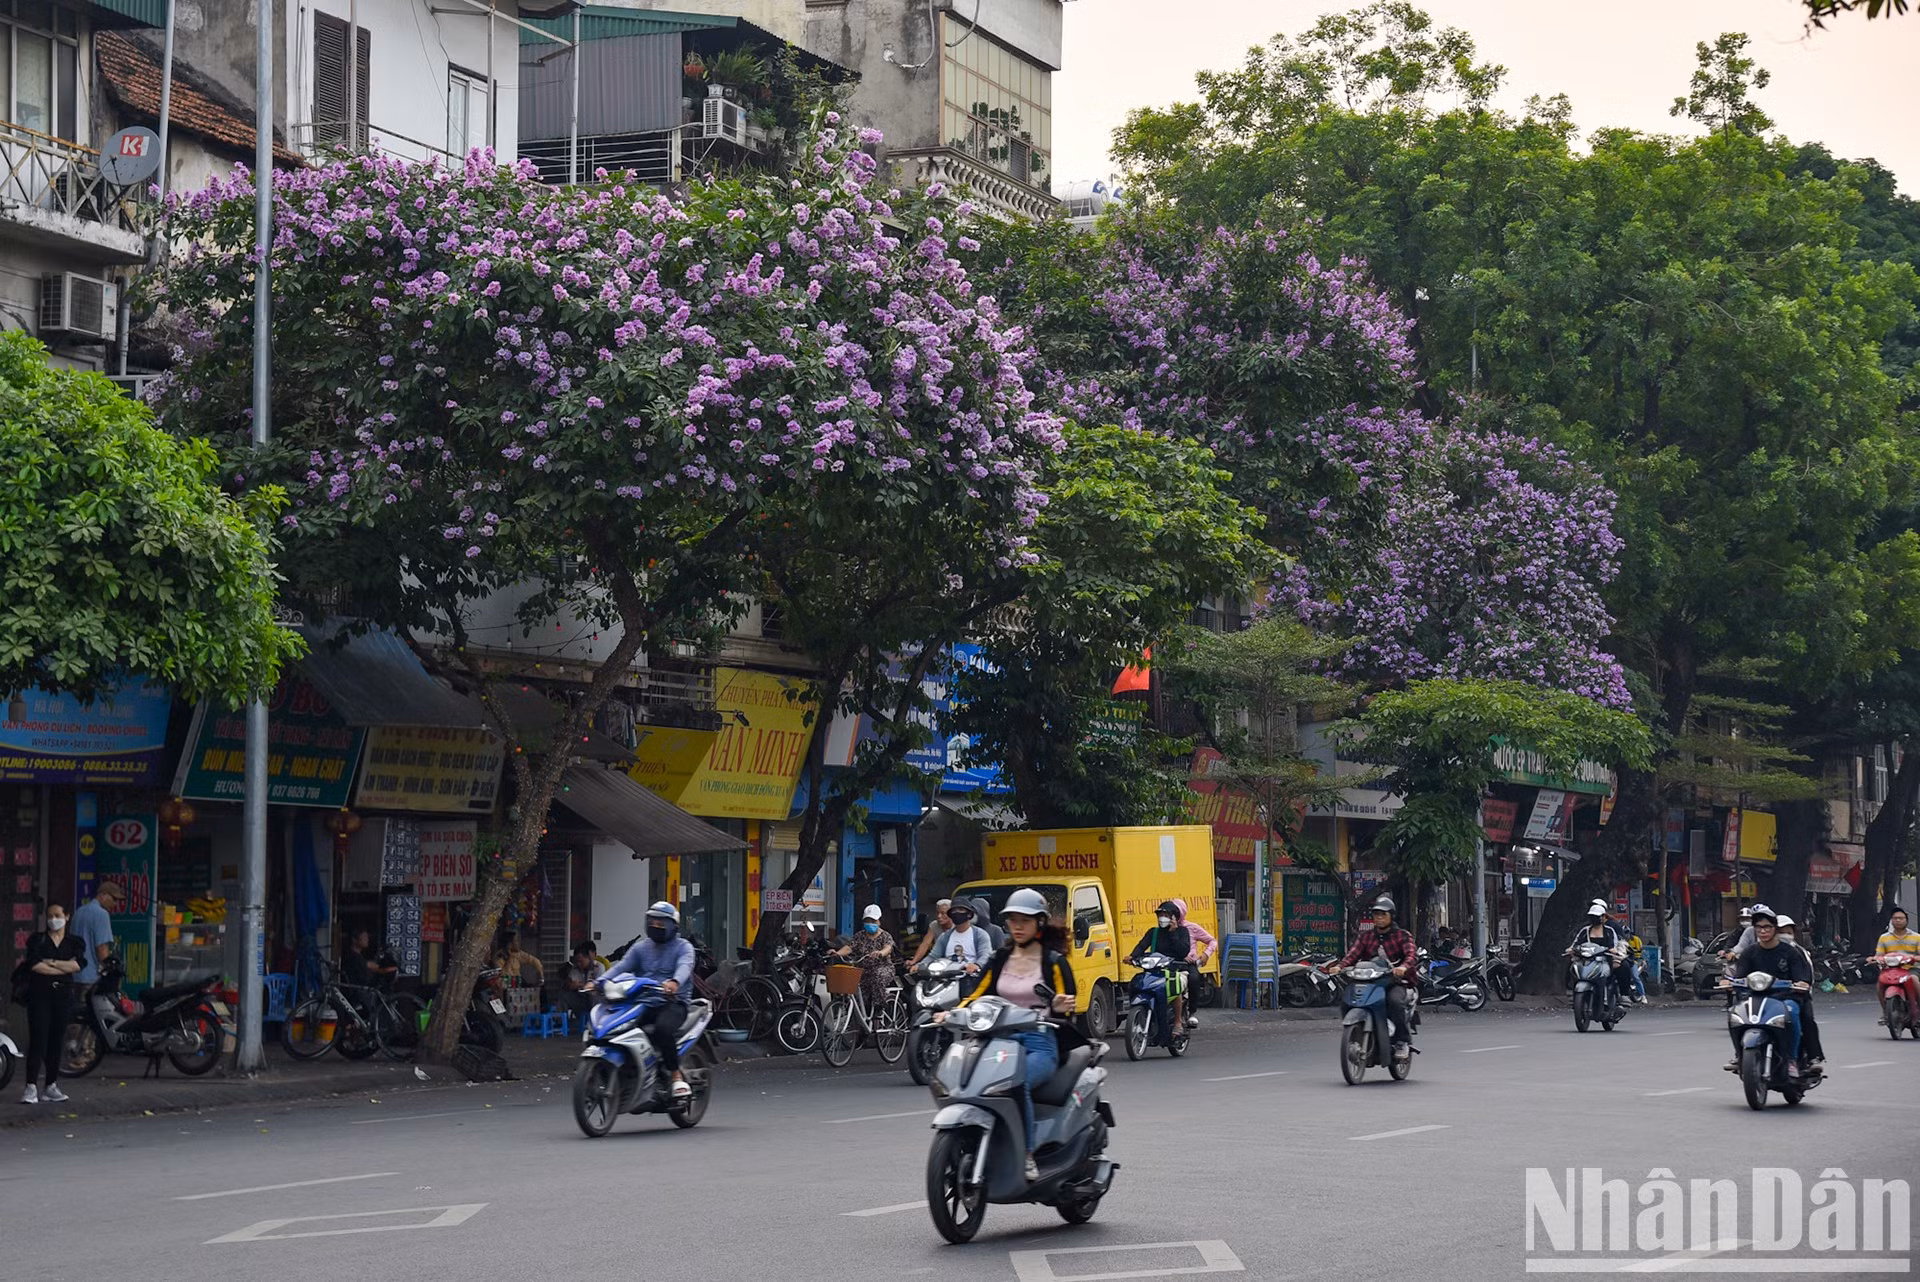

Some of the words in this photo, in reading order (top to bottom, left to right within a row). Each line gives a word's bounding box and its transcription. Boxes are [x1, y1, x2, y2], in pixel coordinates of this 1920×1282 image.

[747, 728, 806, 777] MINH
[110, 822, 142, 845] 62
[433, 844, 457, 877] BIỂN
[999, 856, 1017, 872] XE
[1022, 852, 1050, 870] BƯU
[1056, 850, 1099, 870] CHÍNH
[440, 882, 450, 896] XE
[1191, 896, 1210, 911] MINH
[407, 911, 419, 920] 54
[390, 924, 401, 933] 55
[407, 924, 418, 933] 56
[406, 937, 418, 947] 58
[406, 951, 418, 960] 60
[405, 965, 418, 974] 62
